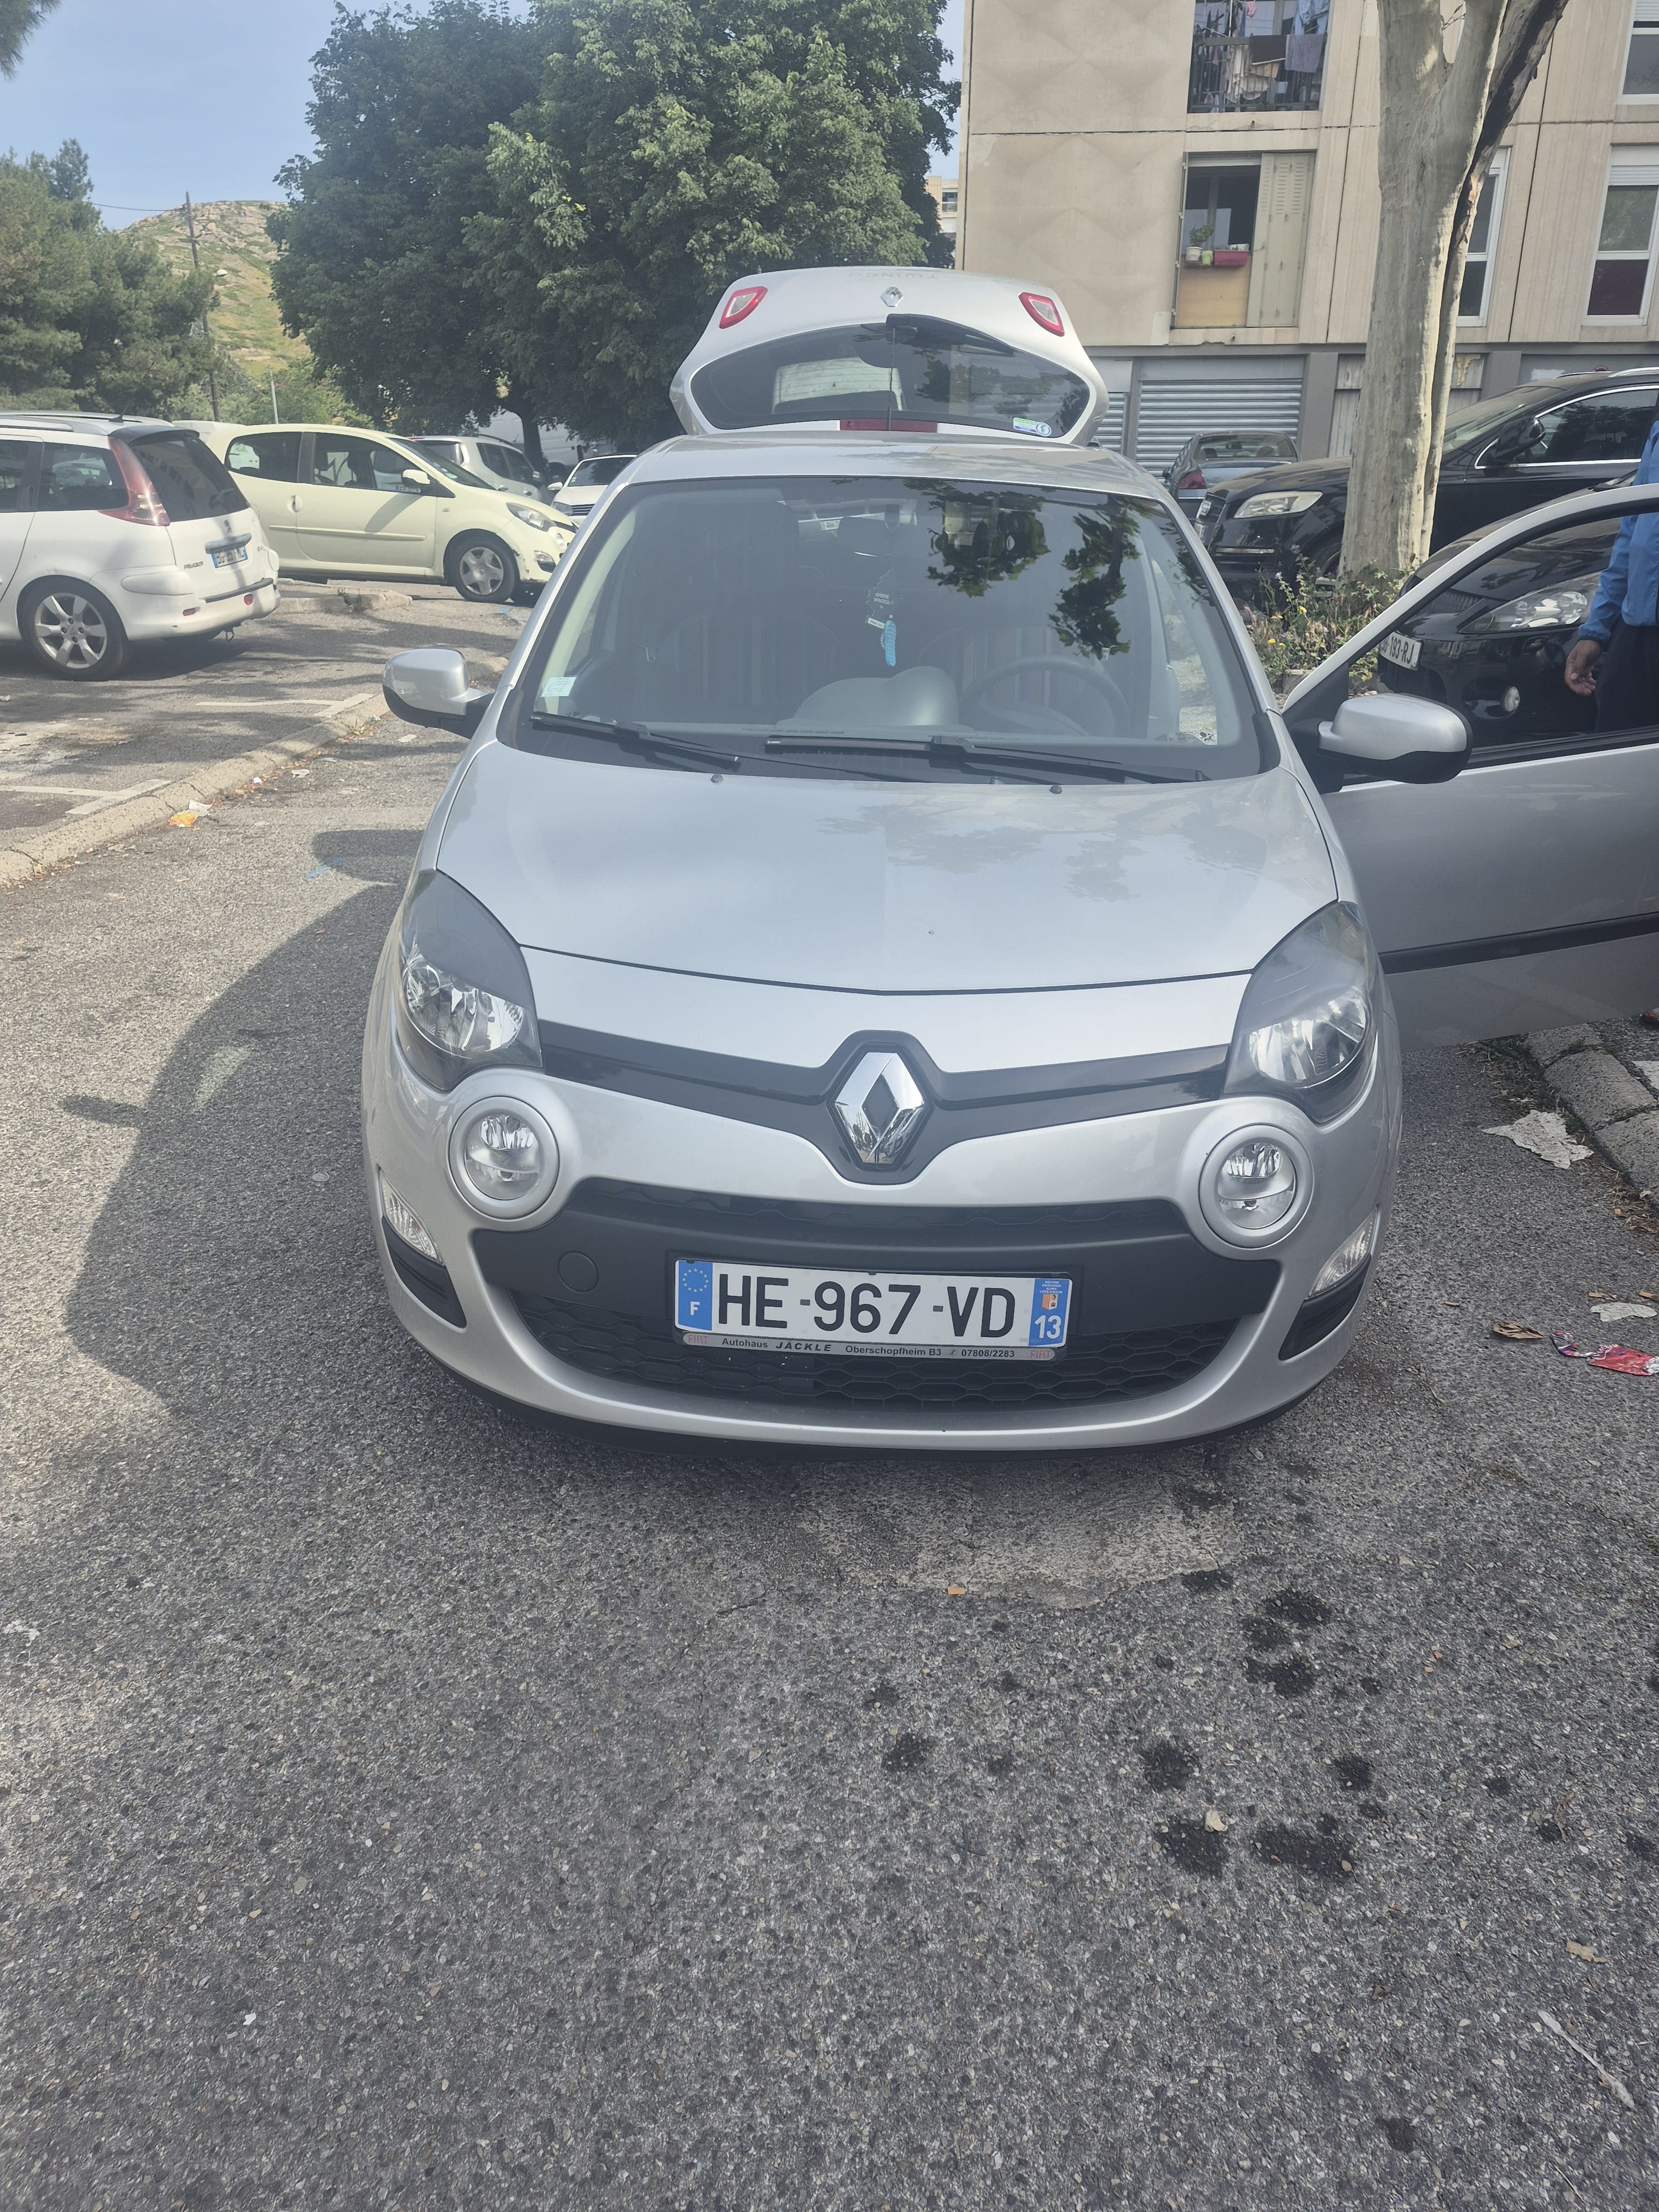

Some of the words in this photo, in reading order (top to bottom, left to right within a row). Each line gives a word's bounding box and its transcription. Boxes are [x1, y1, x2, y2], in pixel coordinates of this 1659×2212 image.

[184, 561, 204, 570] PEUGEOT
[690, 1301, 701, 1316] F
[718, 1274, 1016, 1338] HE-967-VD
[1034, 1314, 1061, 1339] 13
[688, 1335, 708, 1344] FIAT
[722, 1338, 768, 1348] Autohaus
[775, 1340, 832, 1352] JÄCKLE
[845, 1345, 926, 1357] Oberschopfheim
[961, 1349, 1015, 1358] 07808/2283
[1030, 1349, 1051, 1359] FIAT
